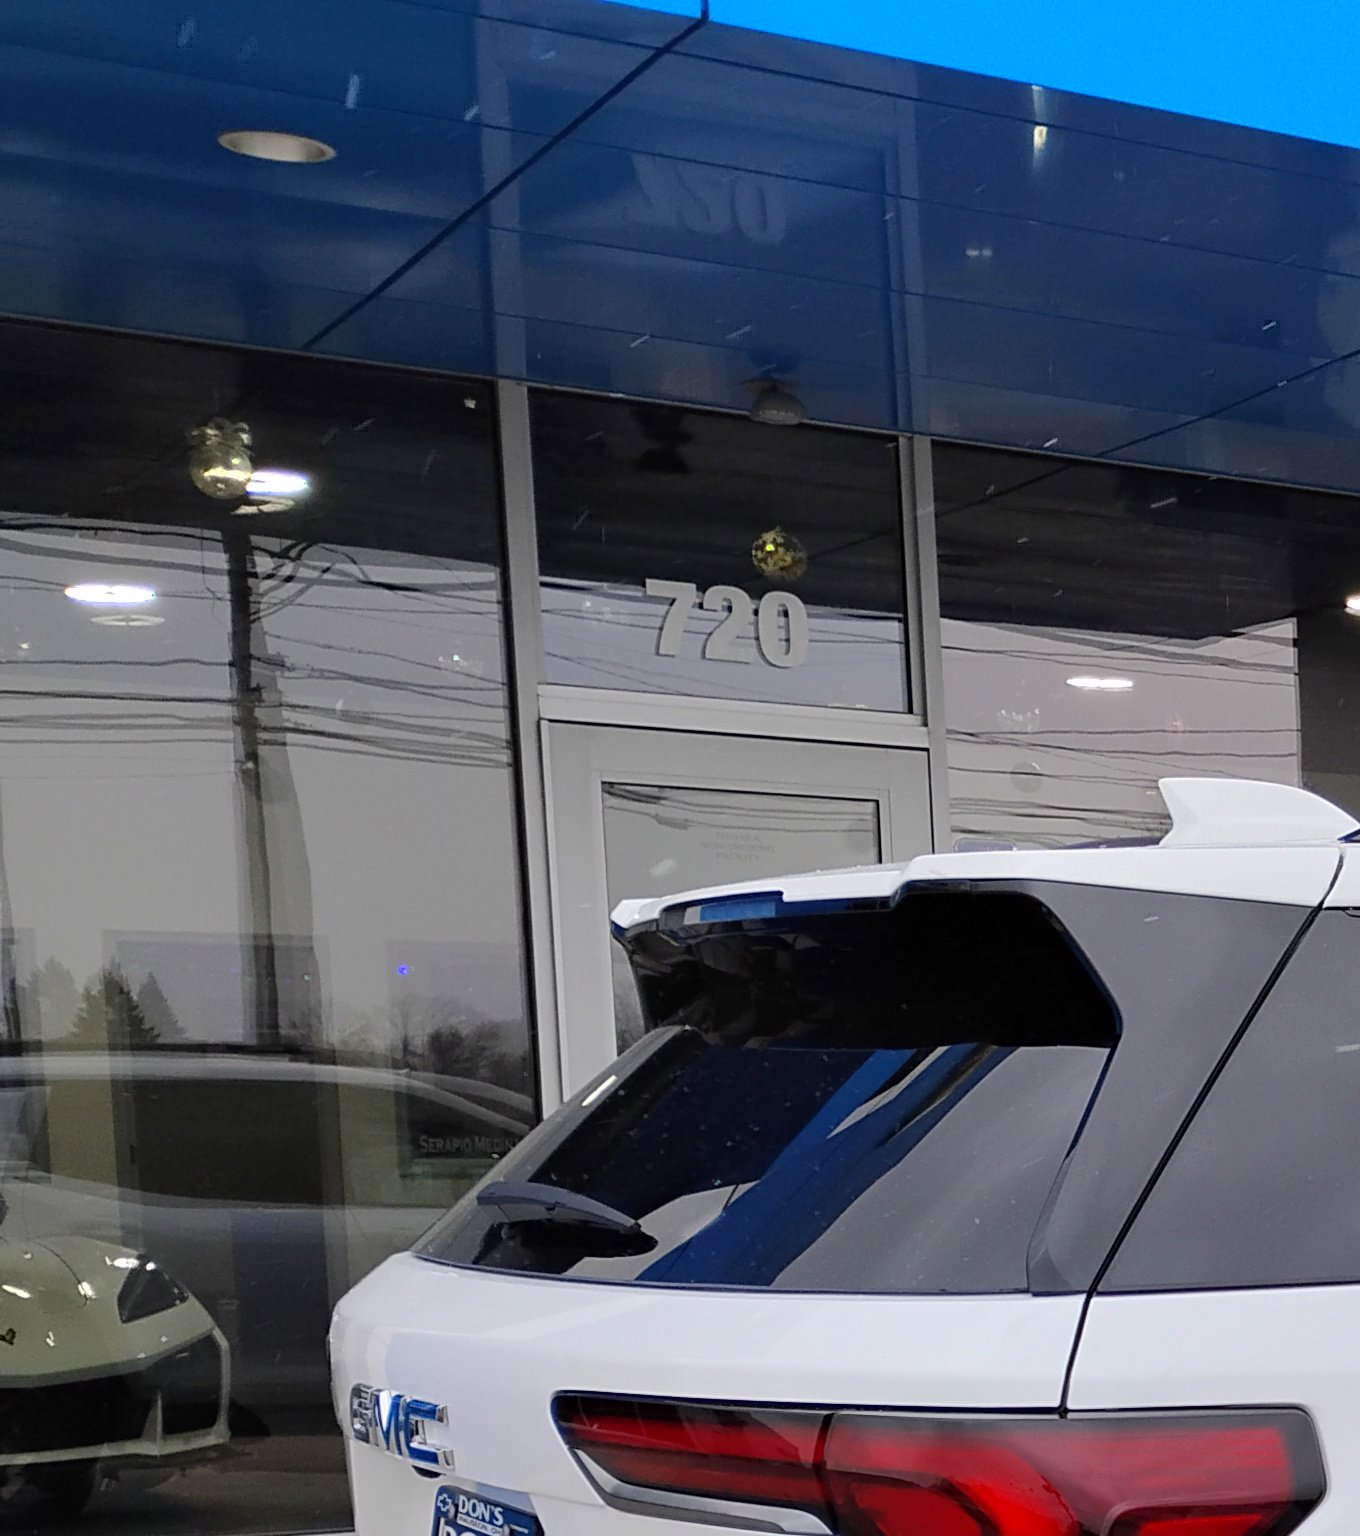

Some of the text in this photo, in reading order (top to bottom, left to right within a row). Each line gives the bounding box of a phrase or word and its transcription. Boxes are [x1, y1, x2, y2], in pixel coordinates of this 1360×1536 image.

[645, 577, 809, 669] 720
[350, 1382, 455, 1473] GMC
[458, 1494, 504, 1526] DON'S
